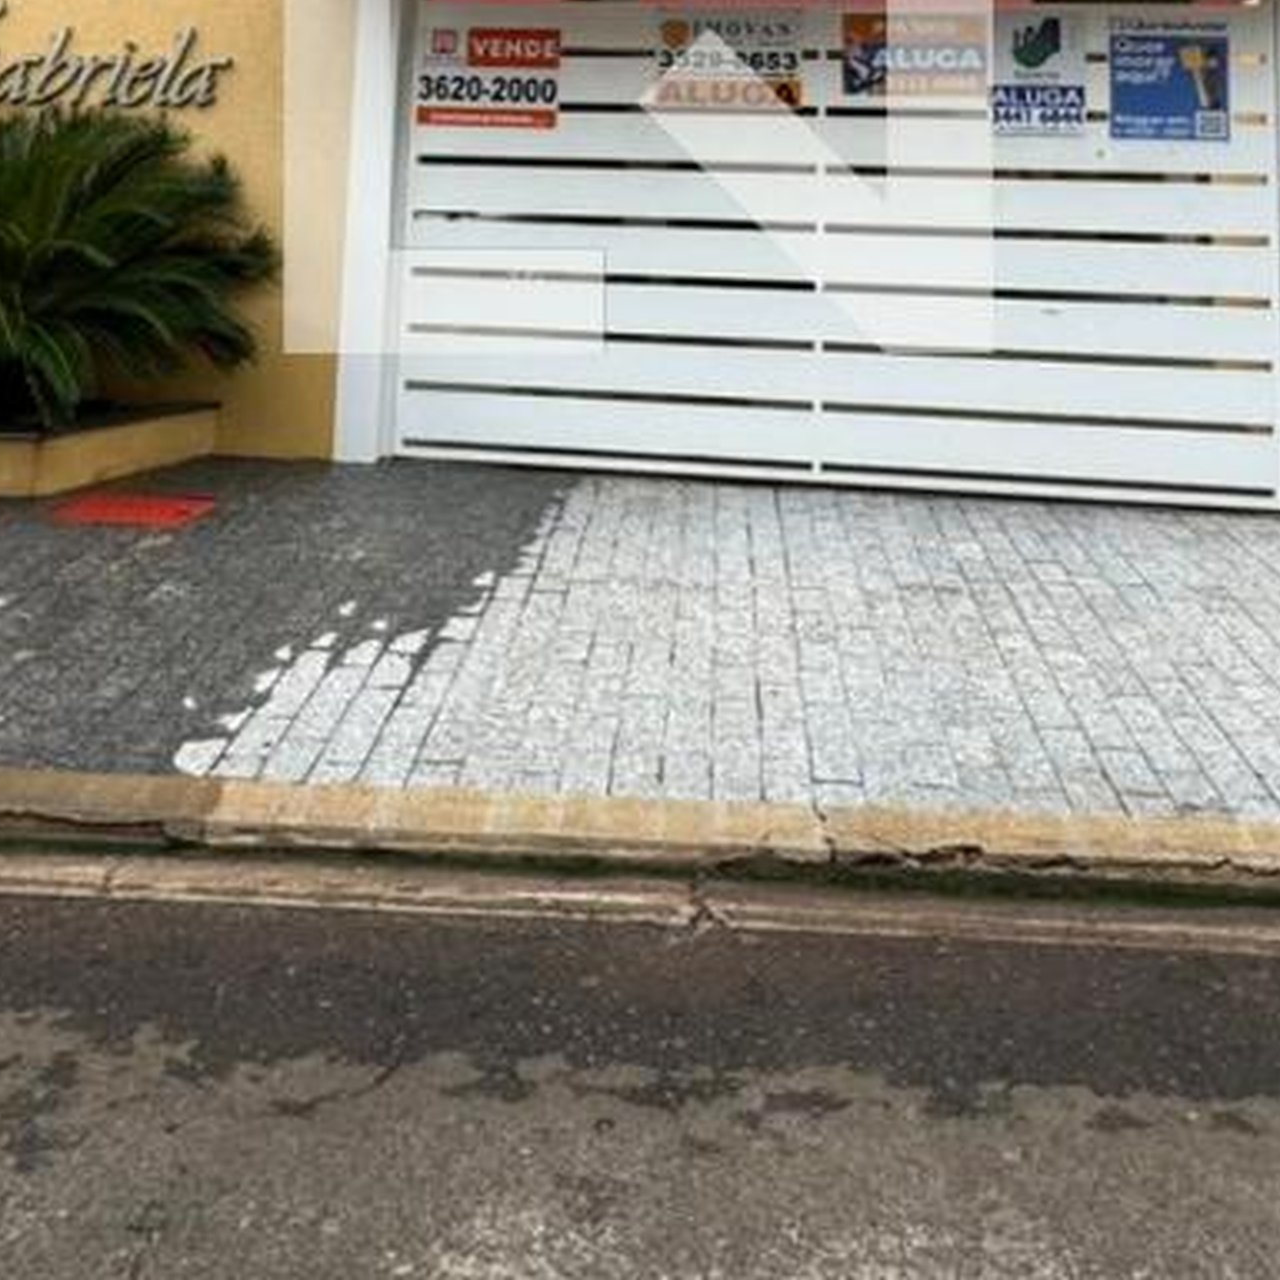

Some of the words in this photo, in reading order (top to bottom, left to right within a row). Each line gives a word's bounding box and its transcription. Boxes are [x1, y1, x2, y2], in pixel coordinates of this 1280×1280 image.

[472, 38, 557, 58] VENDE
[872, 46, 982, 68] ALUGA
[418, 75, 557, 103] 3620-2000
[656, 81, 803, 106] ALUGA
[993, 88, 1083, 105] ALUGA
